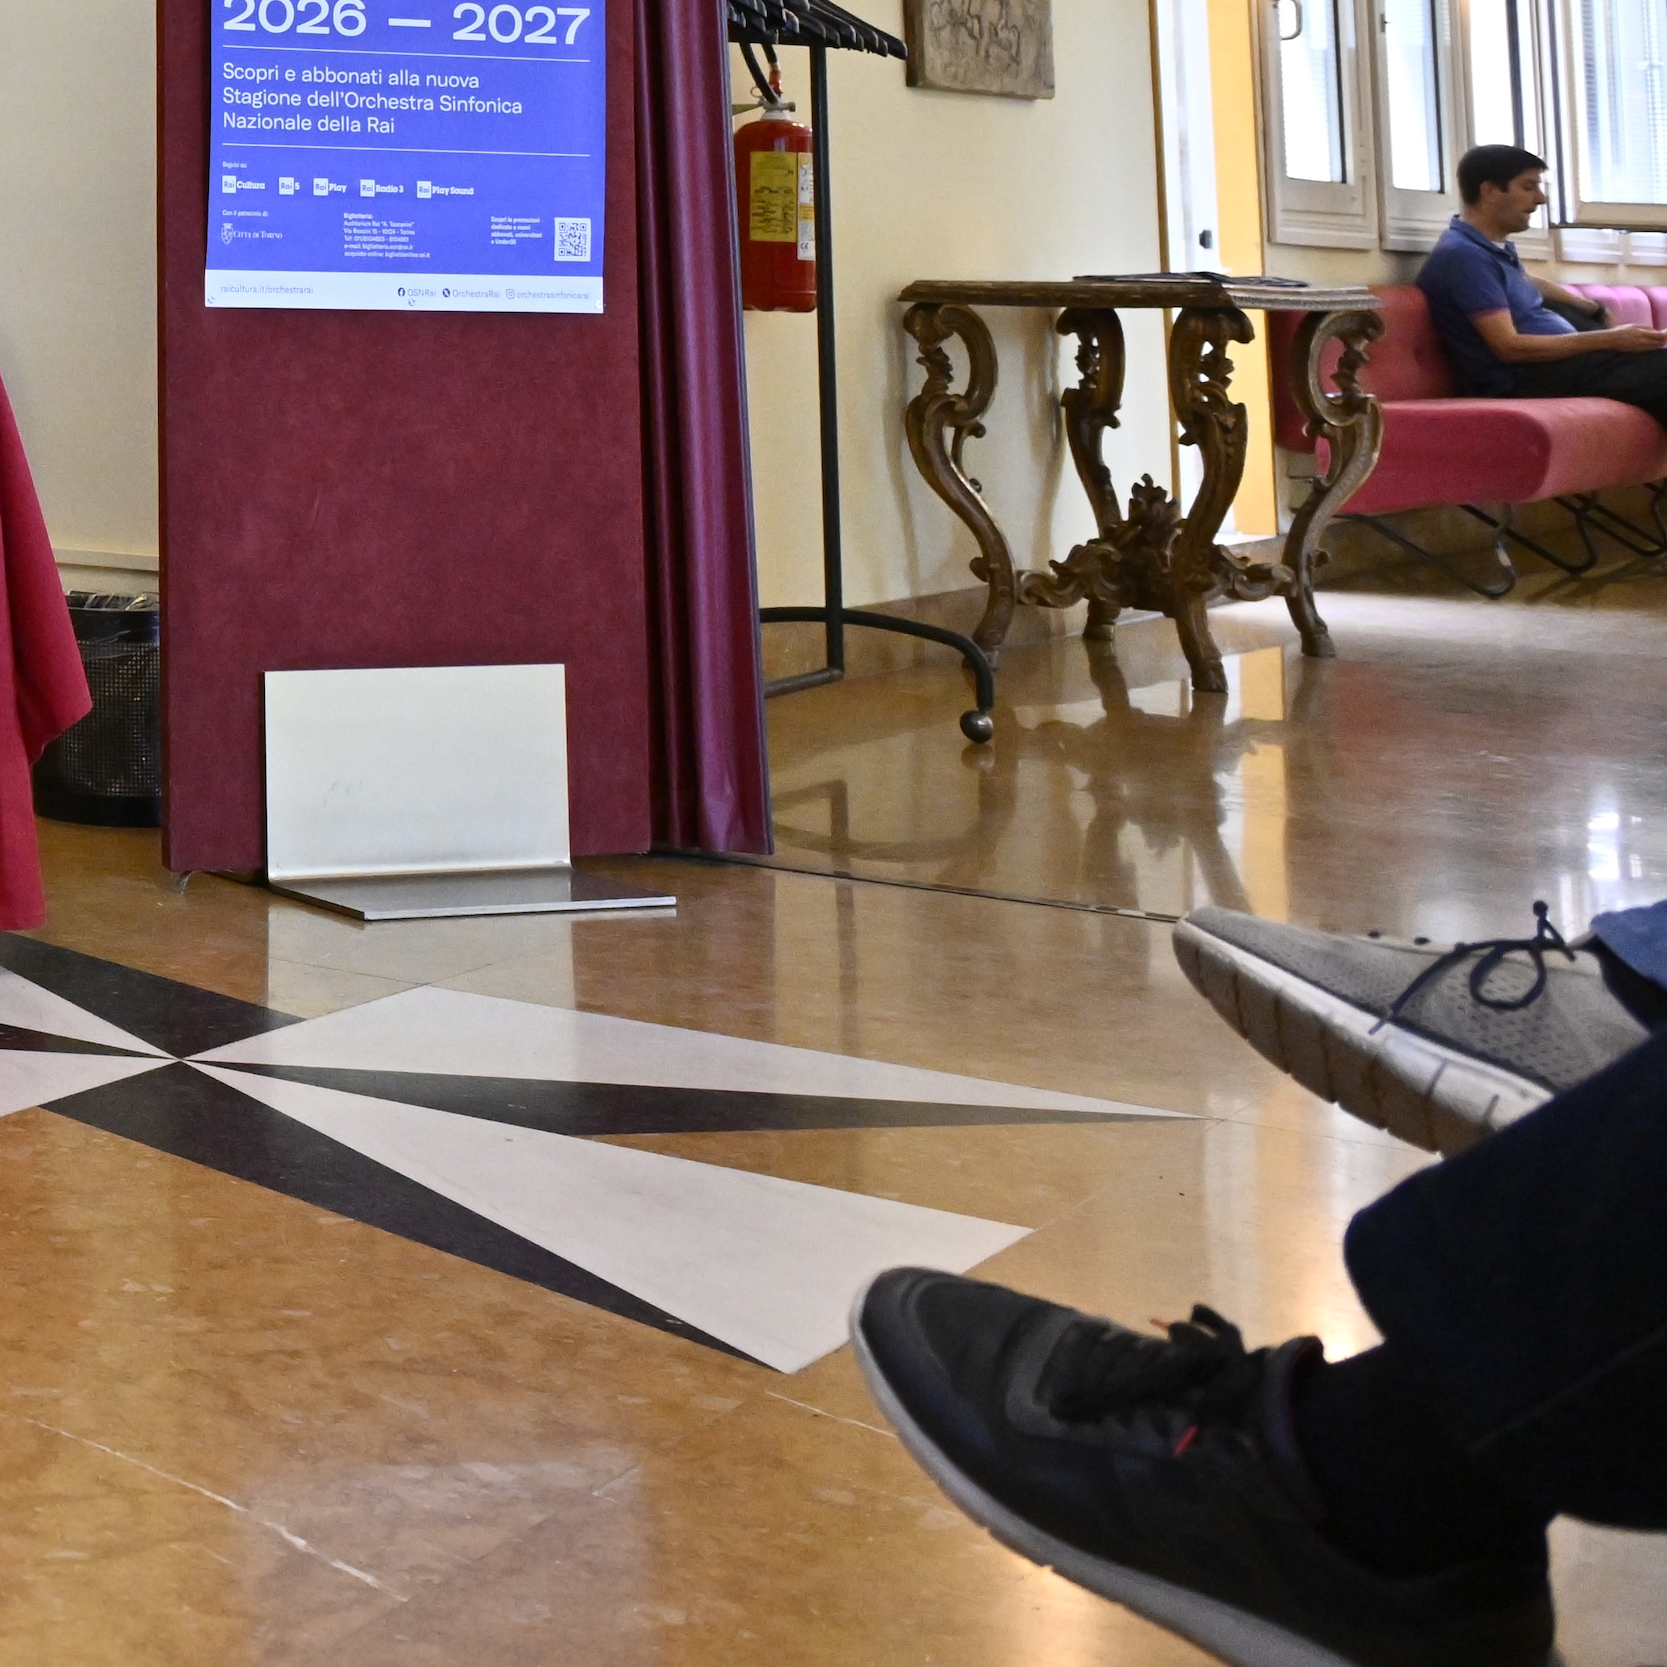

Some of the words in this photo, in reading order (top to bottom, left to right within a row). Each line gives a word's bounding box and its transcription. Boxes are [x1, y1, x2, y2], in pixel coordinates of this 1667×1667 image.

[452, 2, 590, 45] 2027
[223, 63, 279, 84] Scopri
[285, 67, 296, 81] e
[302, 66, 382, 85] abbonati
[388, 70, 420, 87] alla
[426, 74, 479, 89] nuova
[223, 87, 301, 109] Stagione
[439, 95, 522, 114] Sinfonica
[223, 112, 312, 132] Nazionale
[318, 114, 361, 133] della
[367, 118, 395, 134] Rai
[236, 181, 265, 190] Cultura
[329, 183, 347, 193] Play
[375, 185, 398, 193] Radio
[432, 186, 449, 195] Play
[450, 187, 474, 195] Sound
[220, 284, 314, 295] raicultura.it/orchestrarai
[407, 288, 436, 298] OSNRai
[452, 289, 500, 299] OrchestraRai
[517, 291, 589, 301] orchestrasinfonicarai
